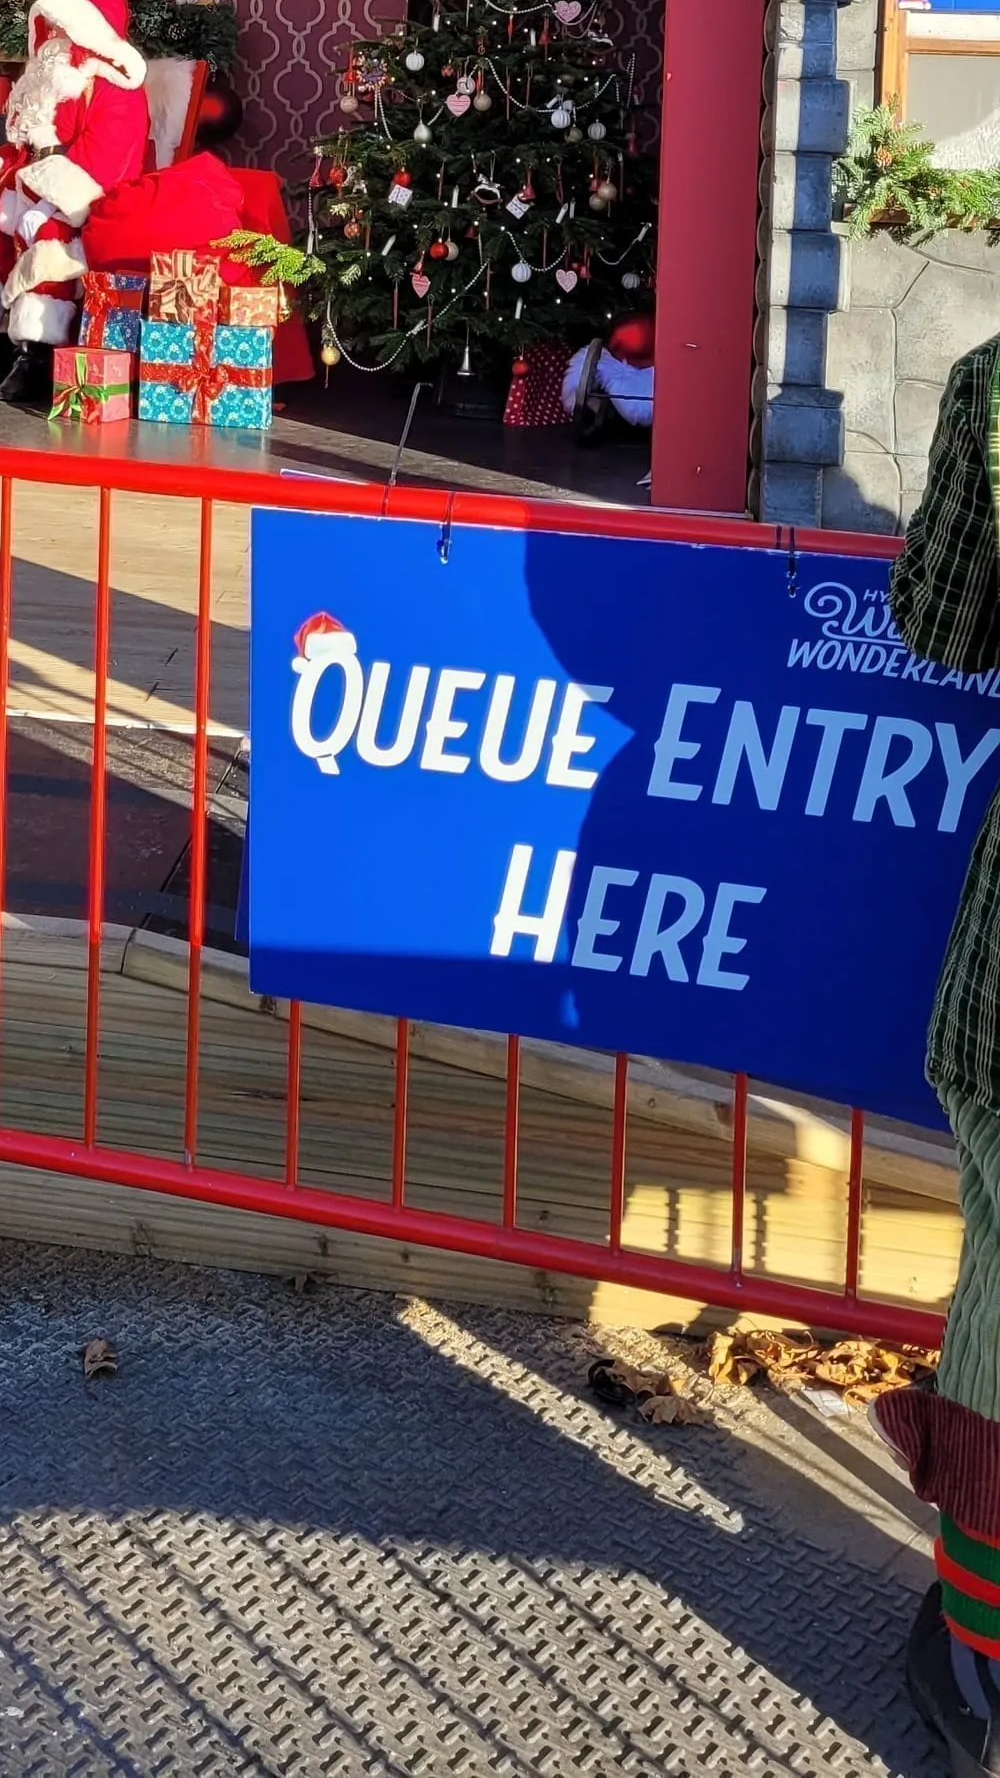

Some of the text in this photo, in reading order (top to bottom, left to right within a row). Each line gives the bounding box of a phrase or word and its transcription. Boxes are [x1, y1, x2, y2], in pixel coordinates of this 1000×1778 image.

[863, 588, 890, 603] HY
[292, 652, 1000, 833] QUEUE ENTRY
[490, 843, 768, 991] HERE
